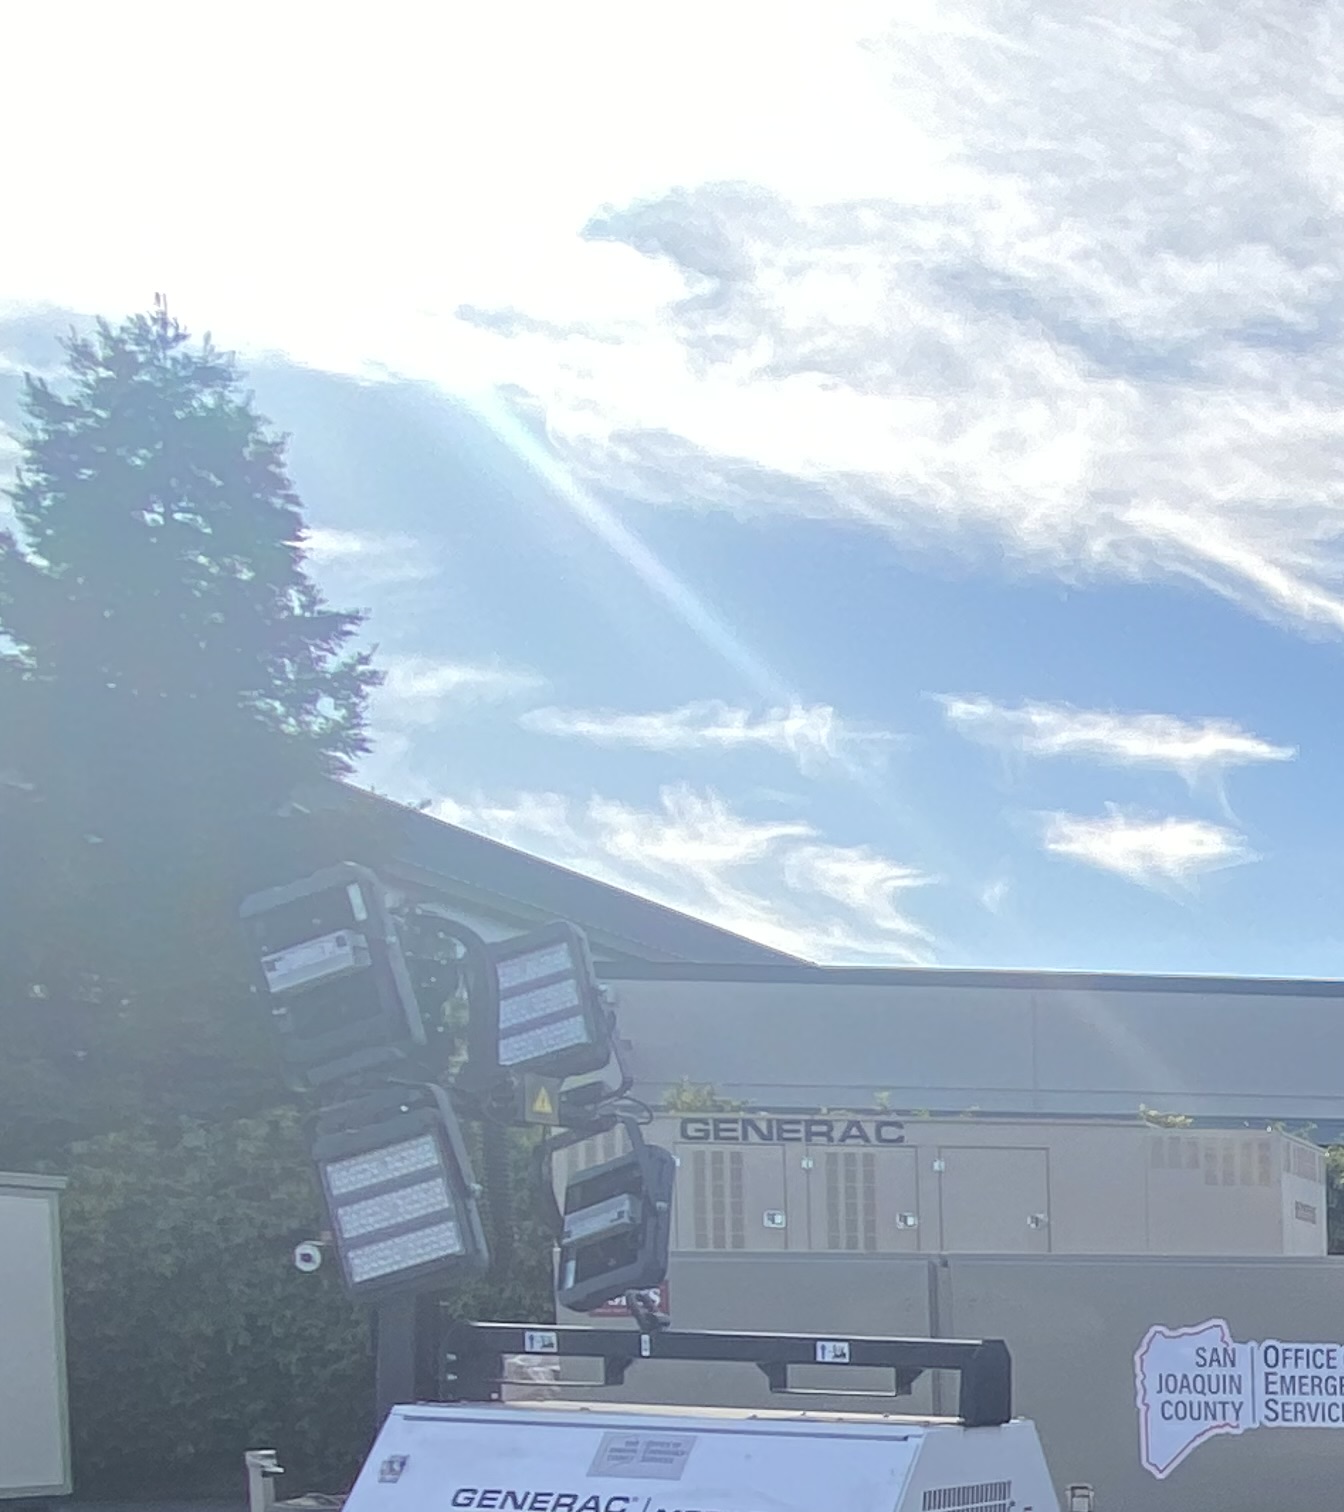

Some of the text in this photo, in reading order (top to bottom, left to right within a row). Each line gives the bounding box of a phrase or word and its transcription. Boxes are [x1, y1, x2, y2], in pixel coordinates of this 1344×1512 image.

[680, 1117, 906, 1144] GENERAC
[1195, 1347, 1237, 1368] SAN
[1263, 1345, 1337, 1370] OFFICE
[1156, 1373, 1243, 1396] JOAQUIN
[1161, 1400, 1244, 1422] COUNTY
